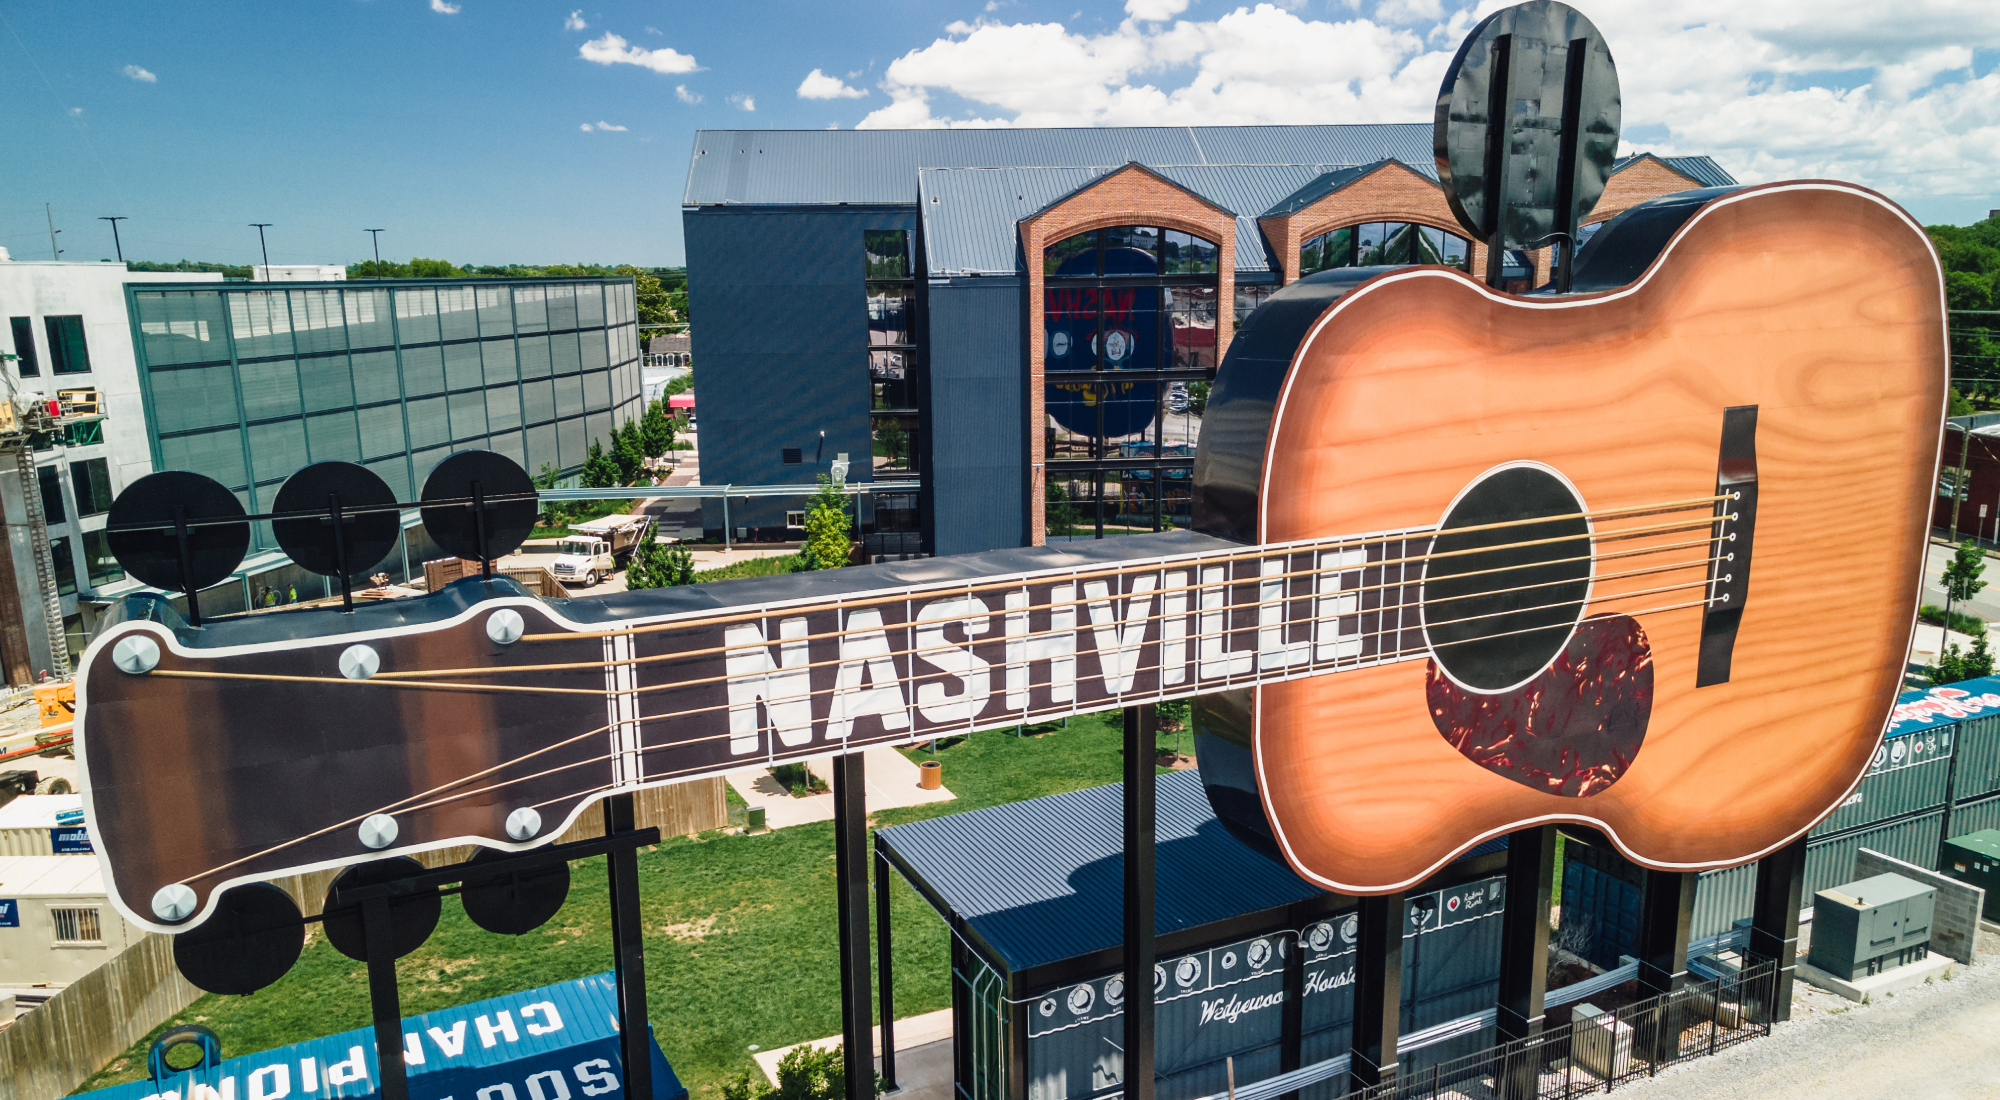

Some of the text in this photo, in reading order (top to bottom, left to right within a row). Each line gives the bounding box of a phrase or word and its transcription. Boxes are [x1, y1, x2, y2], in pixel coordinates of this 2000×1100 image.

[725, 549, 1367, 755] NASHVILLE
[140, 1001, 564, 1100] CHAPION
[1199, 991, 1283, 1026] Wedgewoo
